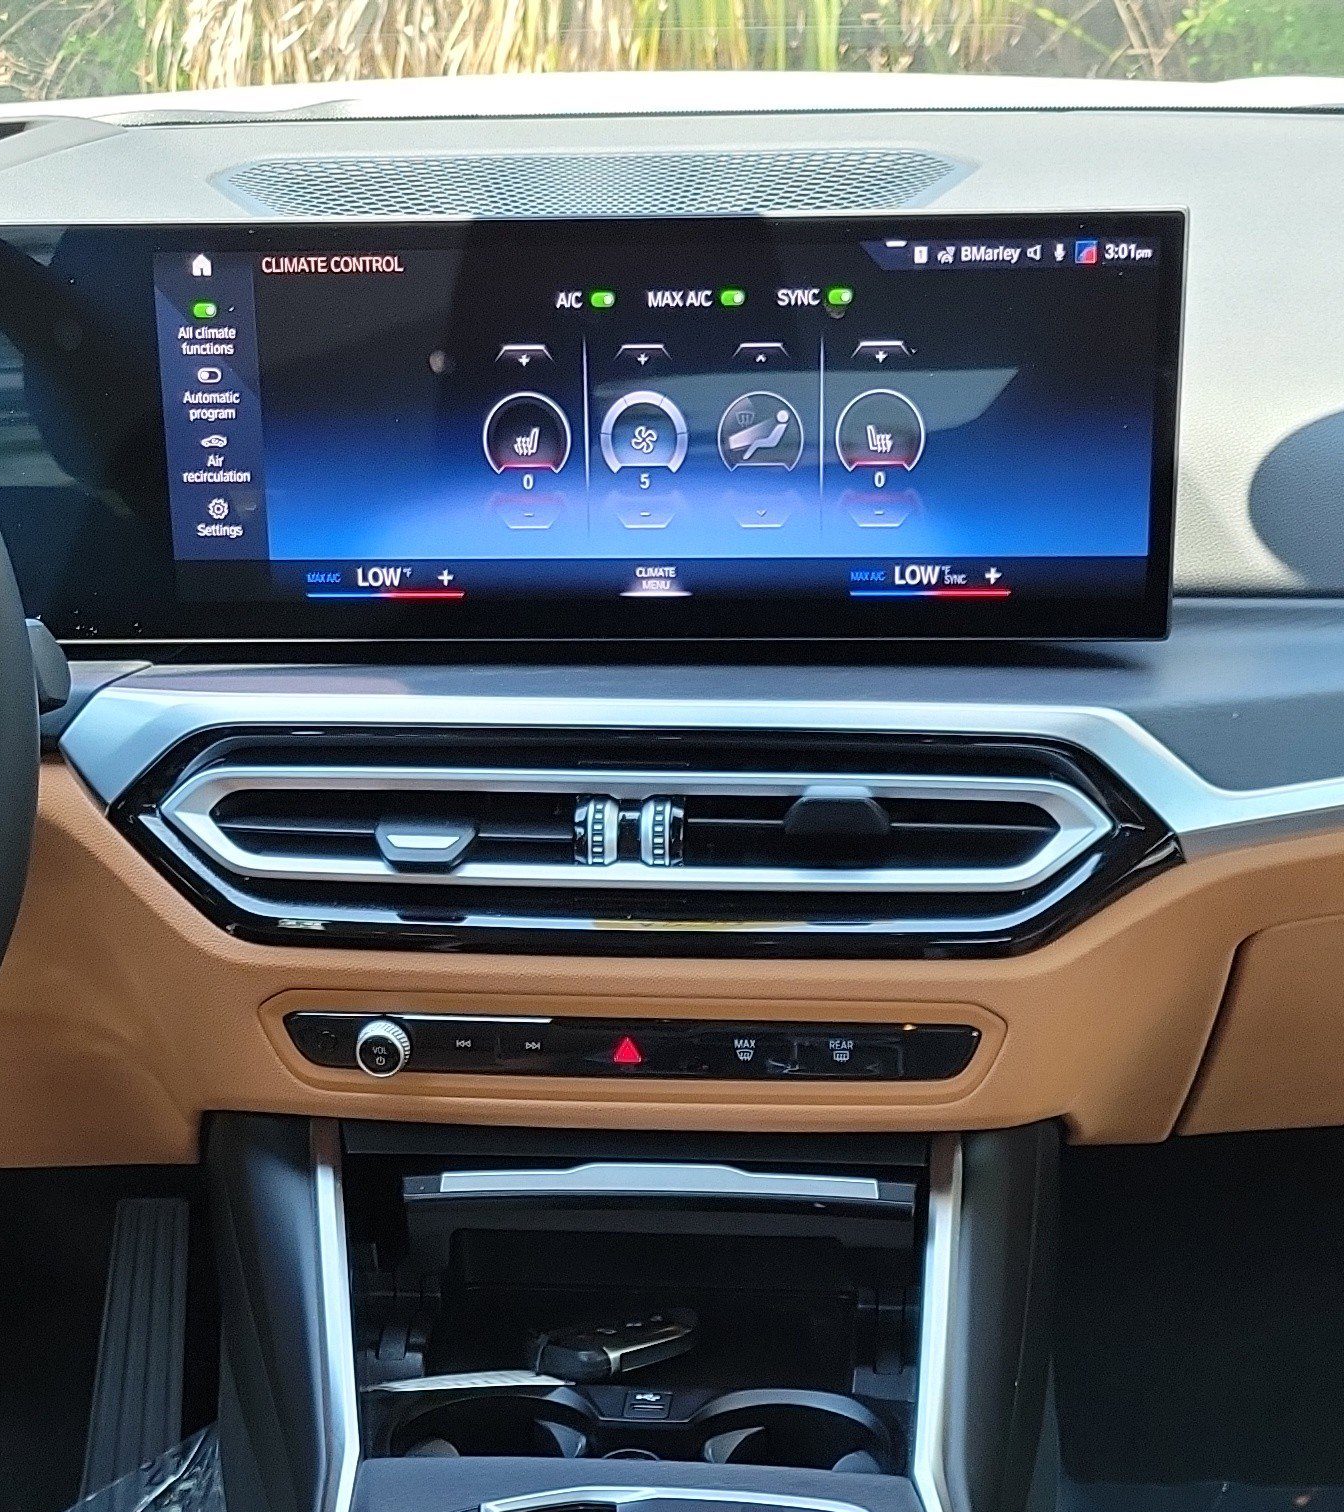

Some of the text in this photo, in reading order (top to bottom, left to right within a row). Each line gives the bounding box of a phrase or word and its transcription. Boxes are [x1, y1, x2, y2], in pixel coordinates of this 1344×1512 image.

[960, 246, 1022, 263] BMarley
[261, 255, 404, 273] CLIMATE CONTROL
[556, 292, 583, 309] A/C
[647, 289, 713, 308] MAX A/C
[776, 288, 821, 306] SYNC
[177, 326, 237, 340] All climate
[181, 342, 235, 356] functions
[182, 391, 241, 405] Automatic
[188, 408, 237, 422] program
[206, 454, 225, 468] Air
[182, 470, 251, 484] recirculation
[522, 474, 534, 490] 0
[639, 473, 651, 490] 5
[873, 471, 886, 488] 0
[196, 523, 244, 539] Settings
[357, 566, 402, 587] LOW
[636, 566, 677, 578] CLIMATE
[894, 564, 941, 586] LOW
[943, 573, 968, 585] SYNC
[642, 579, 672, 590] MENU
[371, 1046, 388, 1055] VOL
[733, 1039, 756, 1050] MAX
[829, 1040, 855, 1051] REAR
